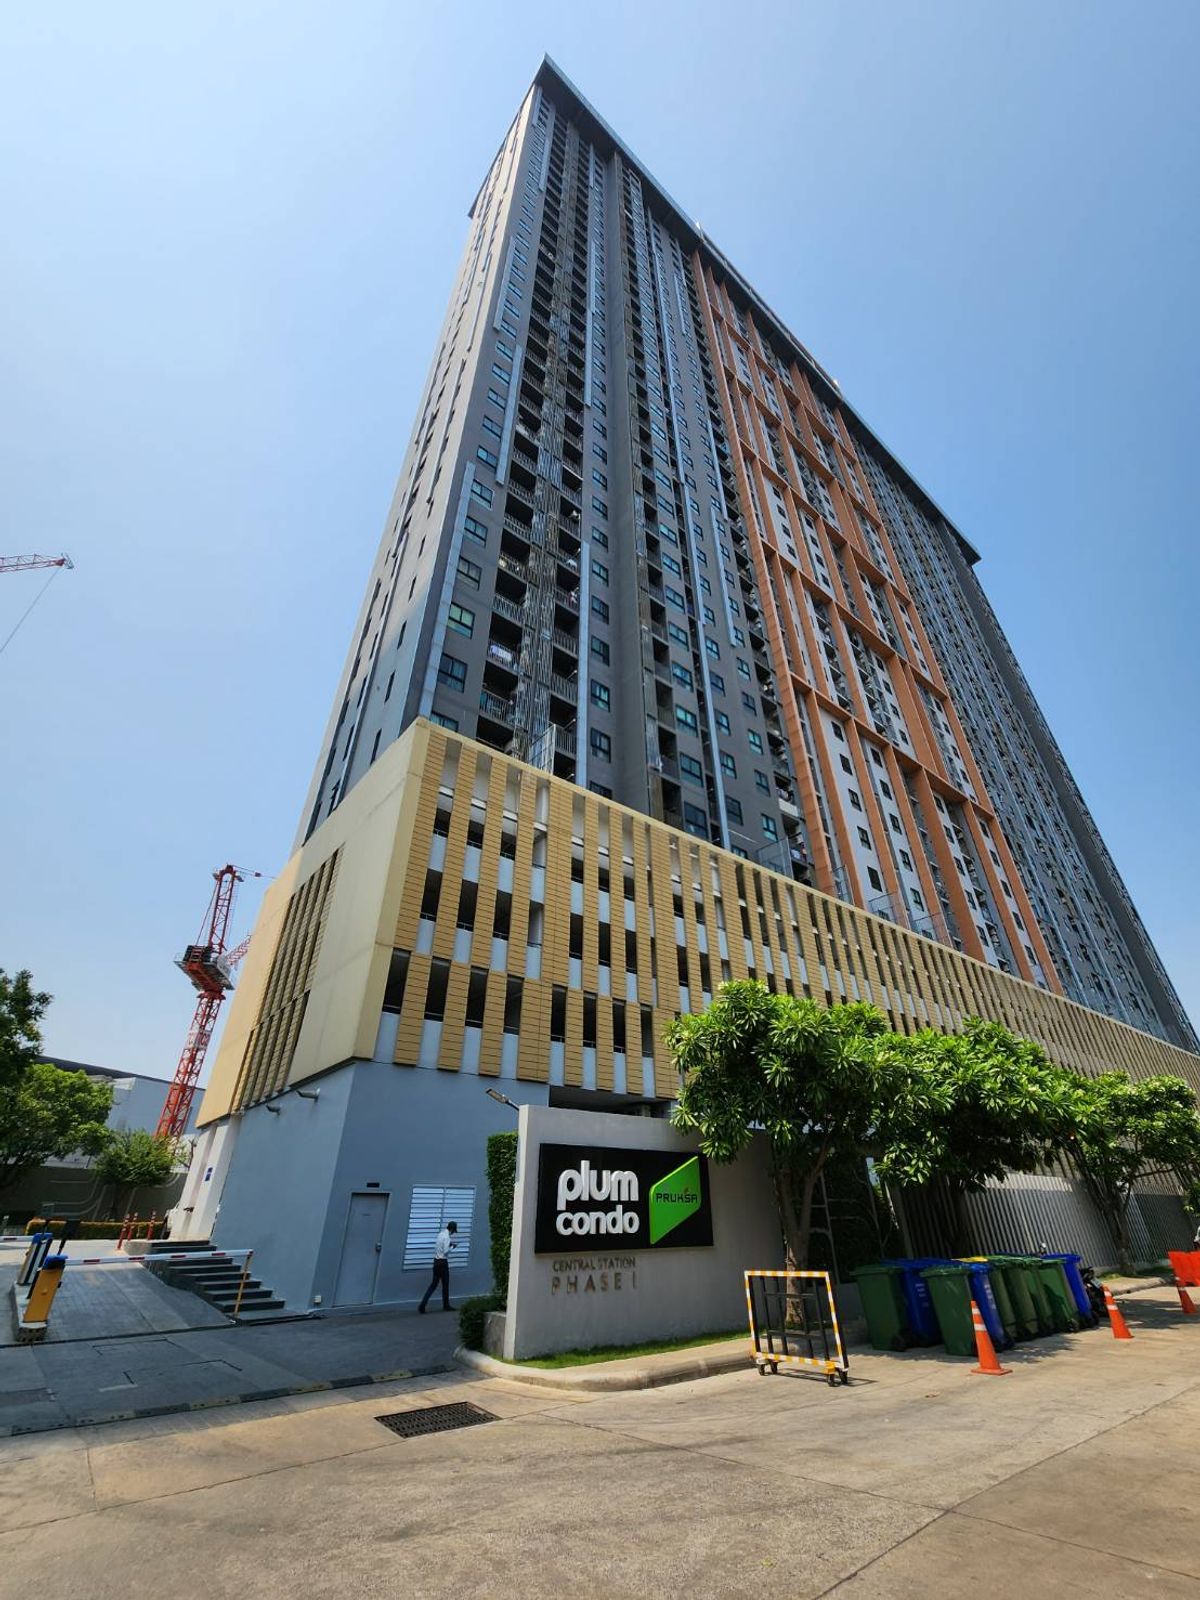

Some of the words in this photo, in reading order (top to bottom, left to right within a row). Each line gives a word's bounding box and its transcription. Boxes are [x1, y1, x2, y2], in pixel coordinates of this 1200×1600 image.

[557, 1160, 639, 1210] plum
[656, 1193, 698, 1203] PRUKSA
[556, 1205, 640, 1235] condo
[553, 1258, 596, 1272] CENTRAL
[552, 1272, 622, 1295] PHASE
